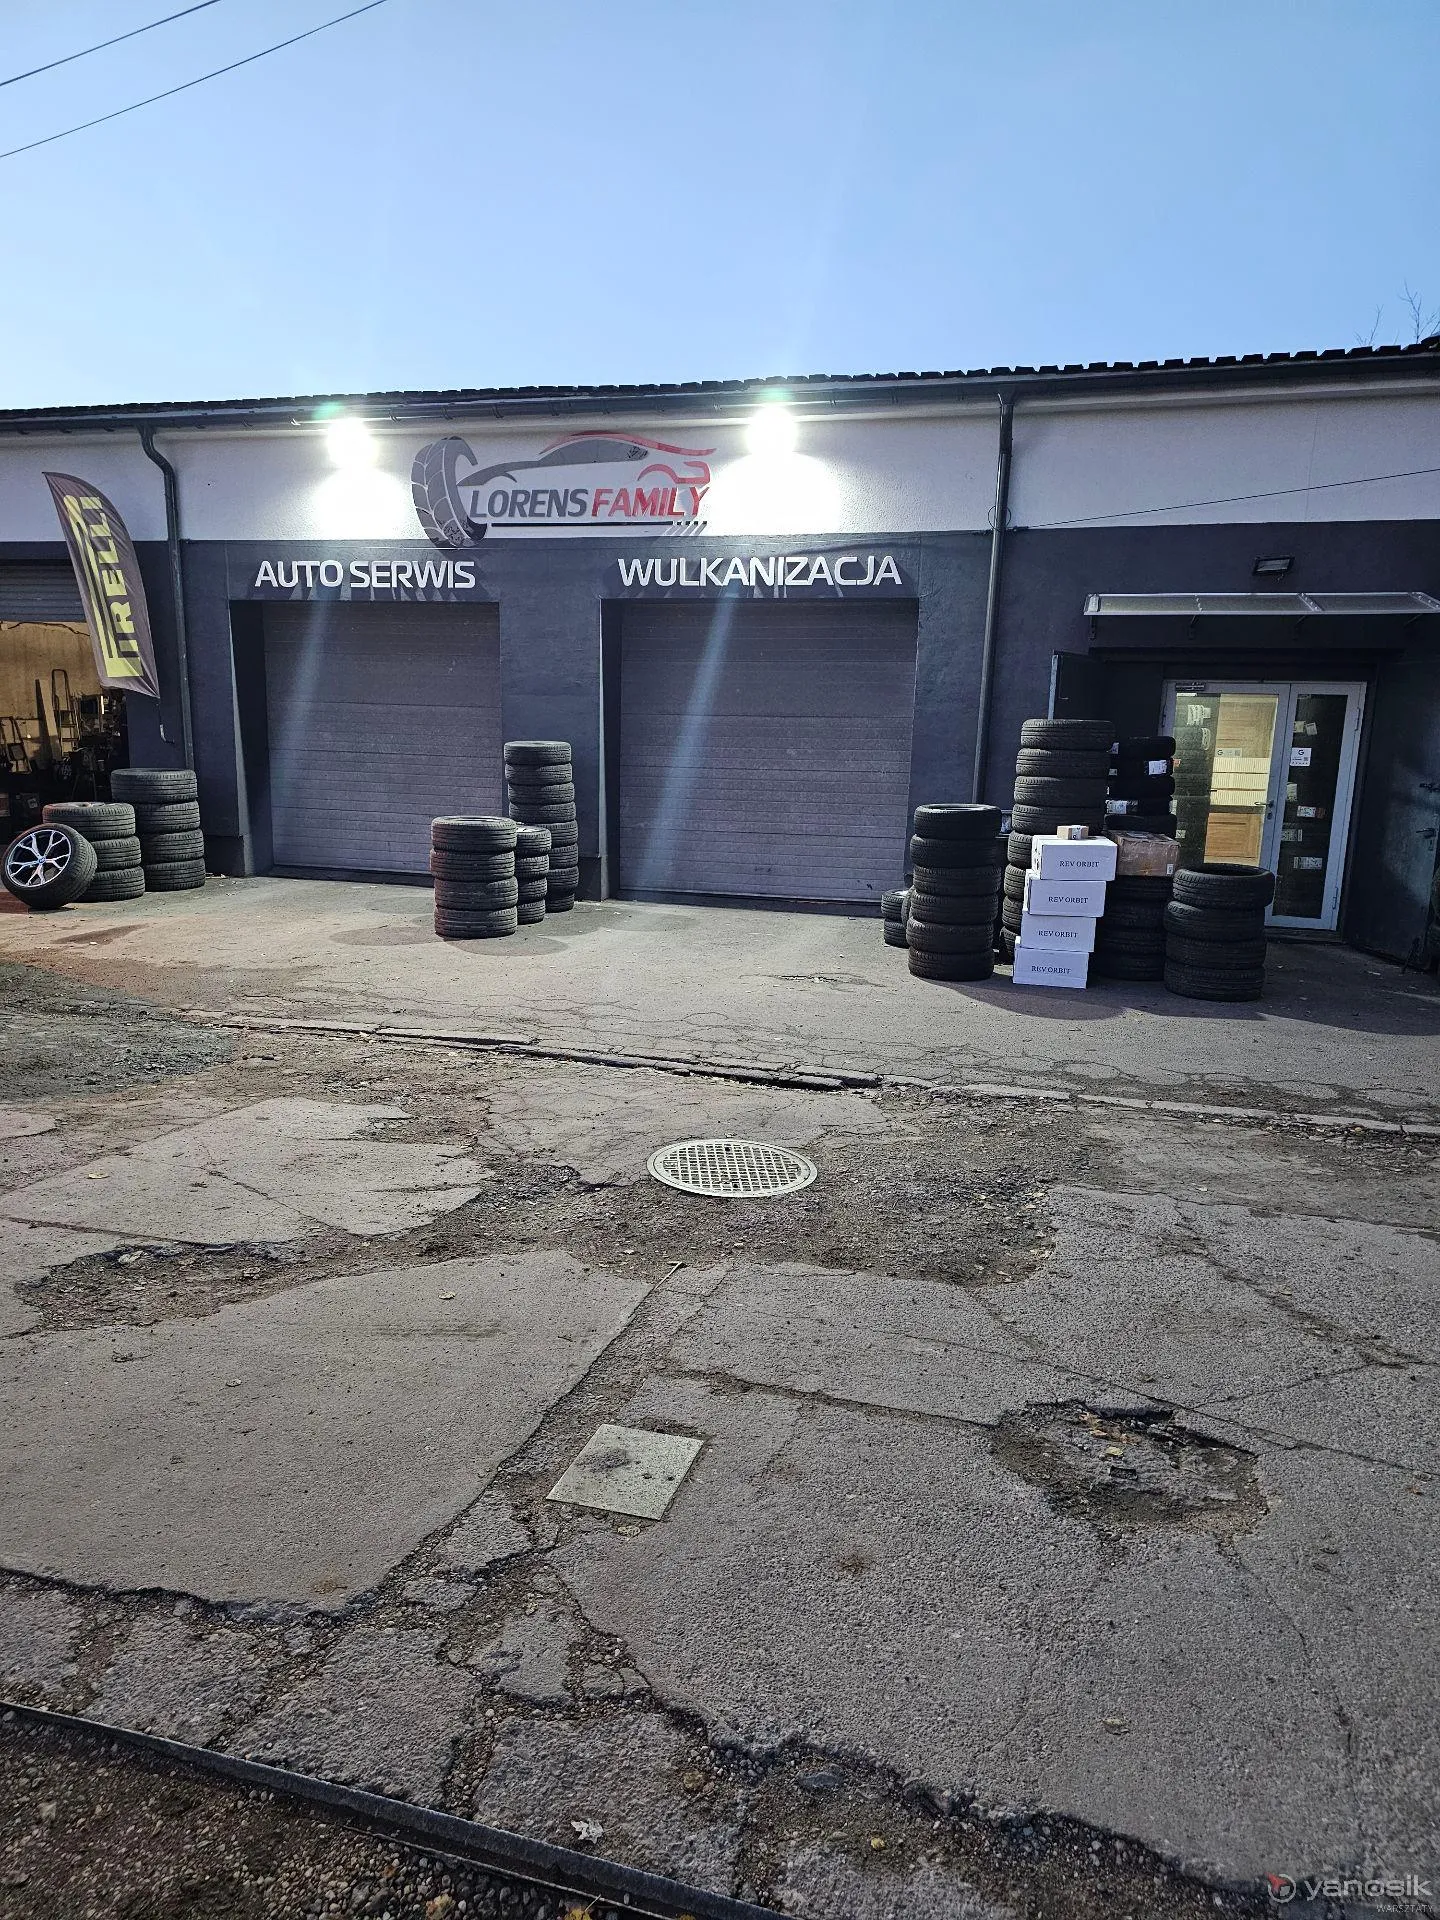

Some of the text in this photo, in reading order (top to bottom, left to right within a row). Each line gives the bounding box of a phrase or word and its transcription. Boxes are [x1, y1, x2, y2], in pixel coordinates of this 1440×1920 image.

[469, 486, 710, 518] LORENS FAMILY
[63, 494, 144, 678] PIRELLI
[254, 559, 476, 589] AUTO SERWIS
[617, 555, 903, 587] WULKANIZACJA
[1059, 860, 1100, 868] REV ORBIT
[1065, 896, 1089, 904] ORBIT
[1031, 965, 1072, 975] REV ORBIT
